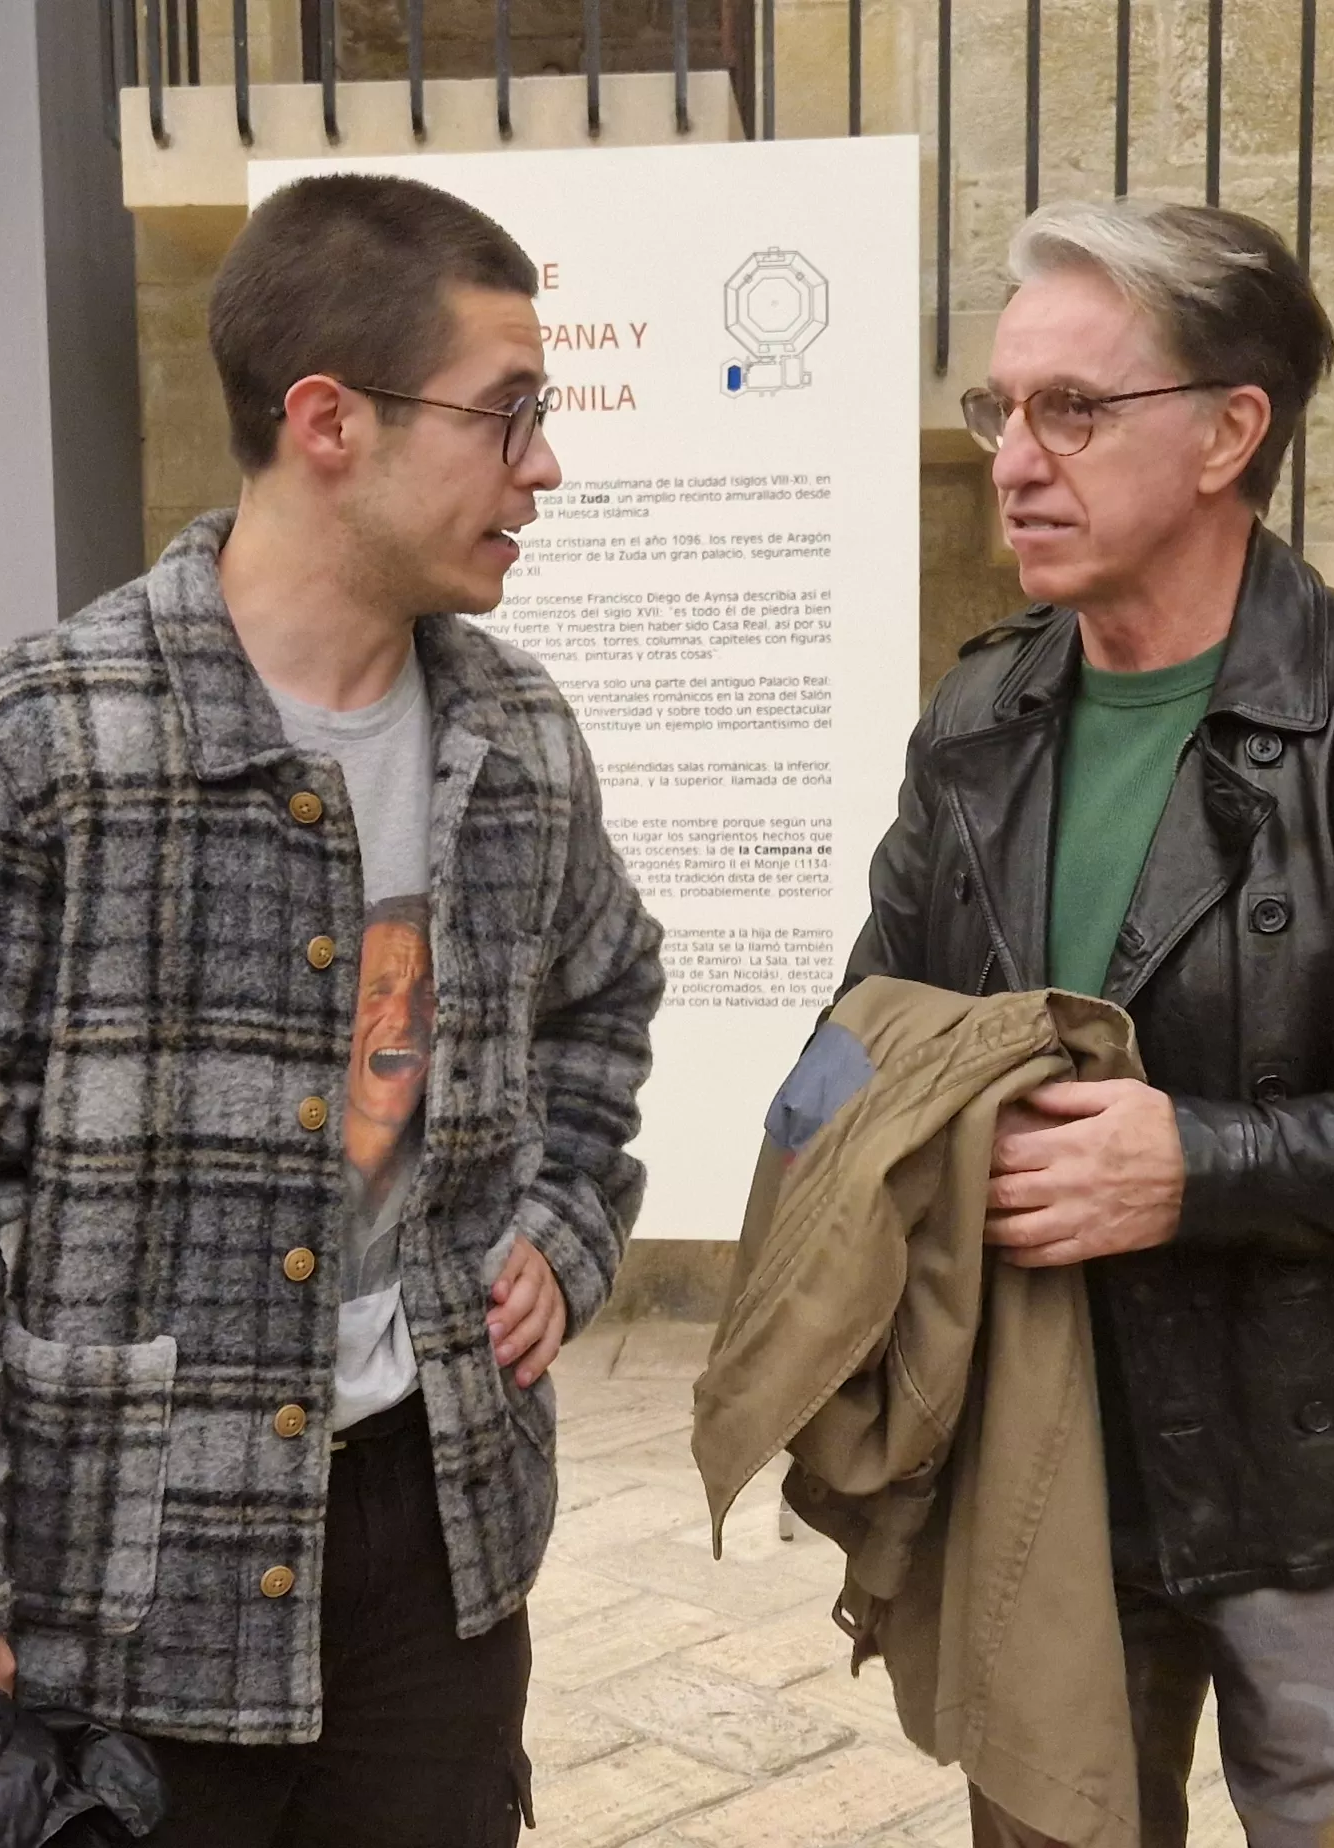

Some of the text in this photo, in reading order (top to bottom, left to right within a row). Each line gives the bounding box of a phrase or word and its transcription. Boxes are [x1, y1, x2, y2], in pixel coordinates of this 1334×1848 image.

[543, 262, 560, 290] E
[539, 321, 648, 351] PANA Y
[544, 384, 637, 413] ONILA
[584, 474, 832, 489] musulmana de la ciudad en
[566, 487, 832, 505] la un amplio recinto amurallado desde
[544, 507, 600, 519] la Huesca
[555, 531, 832, 547] cristiana en el año los reyes de Aragón
[524, 552, 535, 563] el
[538, 552, 583, 563] interior
[585, 550, 602, 562] de
[604, 550, 616, 561] la
[618, 550, 648, 561] Zuda
[650, 551, 667, 560] un
[669, 551, 699, 562] gran
[750, 546, 832, 560] seguramente
[535, 595, 584, 605] oscense
[586, 592, 644, 604] Francisco
[646, 591, 682, 605] Diego
[684, 591, 701, 602] de
[819, 588, 832, 599] el
[512, 608, 577, 619] comienzos
[580, 607, 600, 618] del
[603, 606, 632, 620] siglo
[691, 605, 721, 616] todo
[725, 604, 737, 615] él
[740, 604, 756, 615] de
[760, 603, 800, 617] piedra
[804, 603, 832, 614] bien
[567, 621, 616, 632] muestra
[619, 620, 644, 631] bien
[647, 619, 683, 631] haber
[685, 619, 710, 630] sido
[712, 618, 740, 630] Casa
[793, 619, 814, 630] por
[818, 619, 832, 628] su
[522, 632, 832, 650] por los capiteles con figuras
[584, 649, 634, 662] pinturas
[646, 648, 678, 659] otras
[602, 675, 800, 690] solo una parte del antiguo Palacio
[587, 691, 650, 702] ventanales
[716, 692, 732, 701] en
[734, 689, 745, 700] la
[747, 691, 776, 700] zona
[778, 689, 798, 700] del
[800, 688, 832, 699] Salón
[584, 706, 653, 717] Universidad
[666, 705, 701, 716] sobre
[704, 704, 734, 716] todo
[736, 706, 752, 715] un
[755, 703, 832, 717] espectacular
[645, 721, 662, 730] un
[664, 718, 714, 732] ejemplo
[813, 717, 833, 728] del
[606, 760, 784, 775] espléndidas salas la
[659, 775, 670, 786] la
[730, 774, 778, 785] llamada
[781, 773, 798, 785] de
[801, 773, 833, 784] doña
[641, 818, 668, 828] este
[671, 817, 719, 828] nombre
[722, 818, 767, 830] porque
[809, 818, 833, 827] una
[632, 829, 833, 844] lugar los sangrientos hechos que
[706, 843, 833, 857] la de la Campana de
[684, 858, 726, 869] Ramiro
[739, 858, 751, 869] el
[754, 857, 791, 871] Monje
[647, 871, 794, 883] esta tradición dista de ser
[777, 886, 834, 898] posterior
[738, 927, 749, 938] la
[751, 927, 772, 940] hija
[774, 927, 790, 938] de
[791, 927, 834, 938] Ramiro
[691, 940, 834, 951] Sala se la llamó también
[679, 954, 834, 965] de La tal vez
[689, 968, 834, 979] de San destaca
[770, 984, 786, 993] en
[789, 982, 807, 993] los
[813, 984, 834, 995] que
[688, 996, 797, 1007] con la Natividad de
